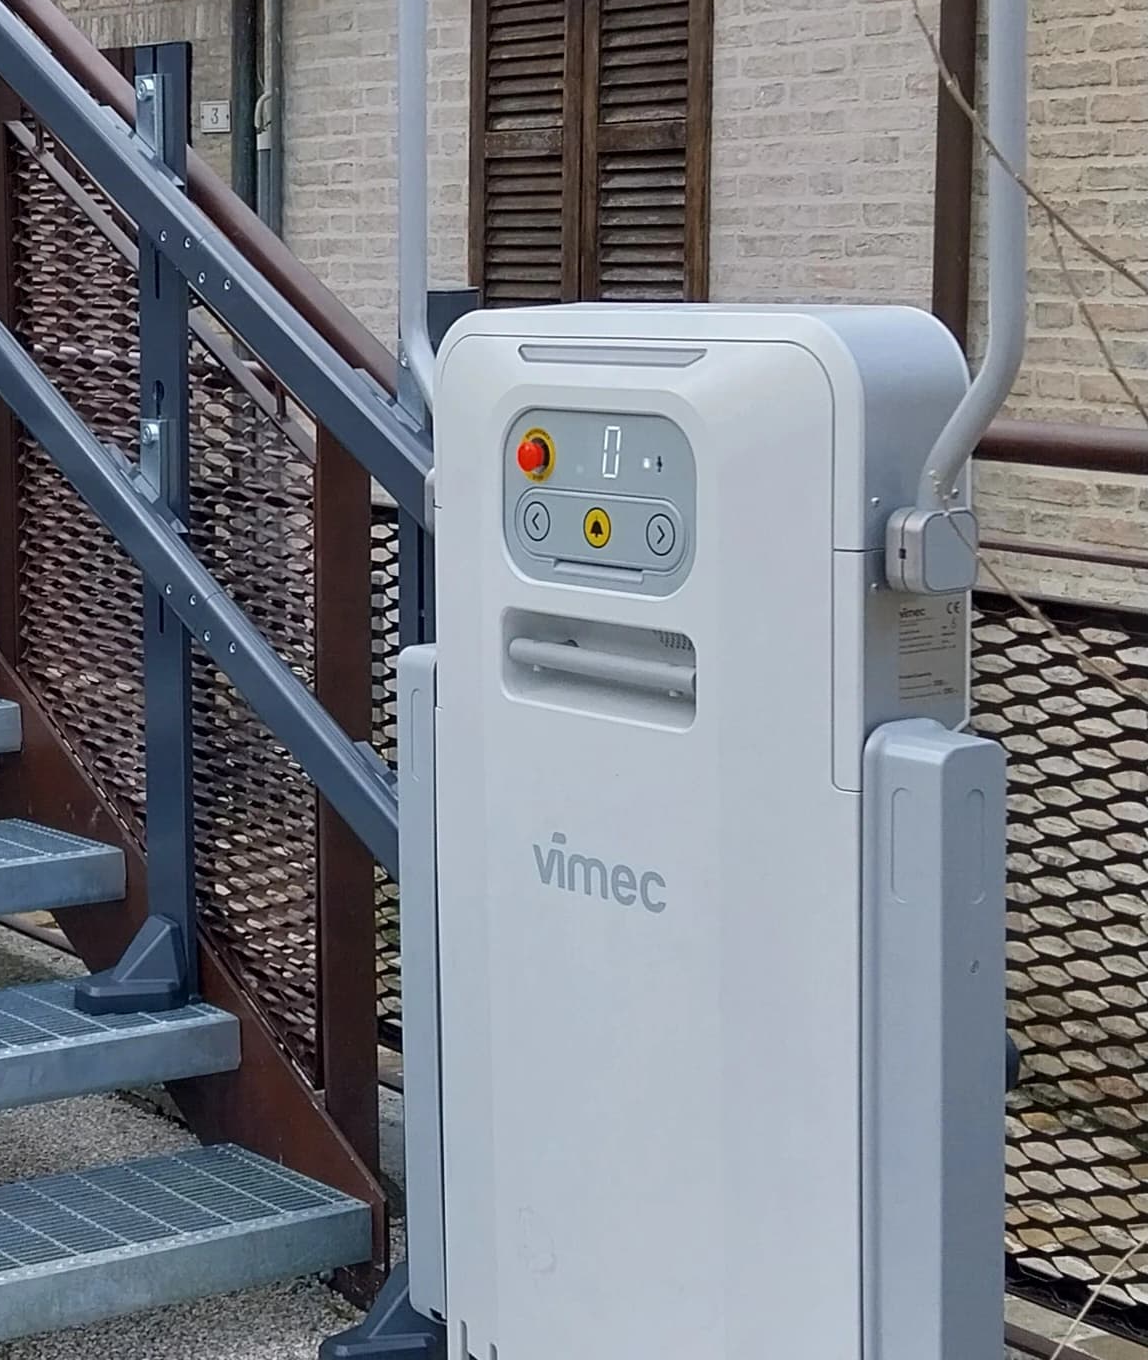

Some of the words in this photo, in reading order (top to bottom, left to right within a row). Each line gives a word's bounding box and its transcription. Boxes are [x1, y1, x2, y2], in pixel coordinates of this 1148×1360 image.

[211, 107, 219, 124] 3
[602, 425, 622, 479] 0
[532, 831, 667, 913] vimec
